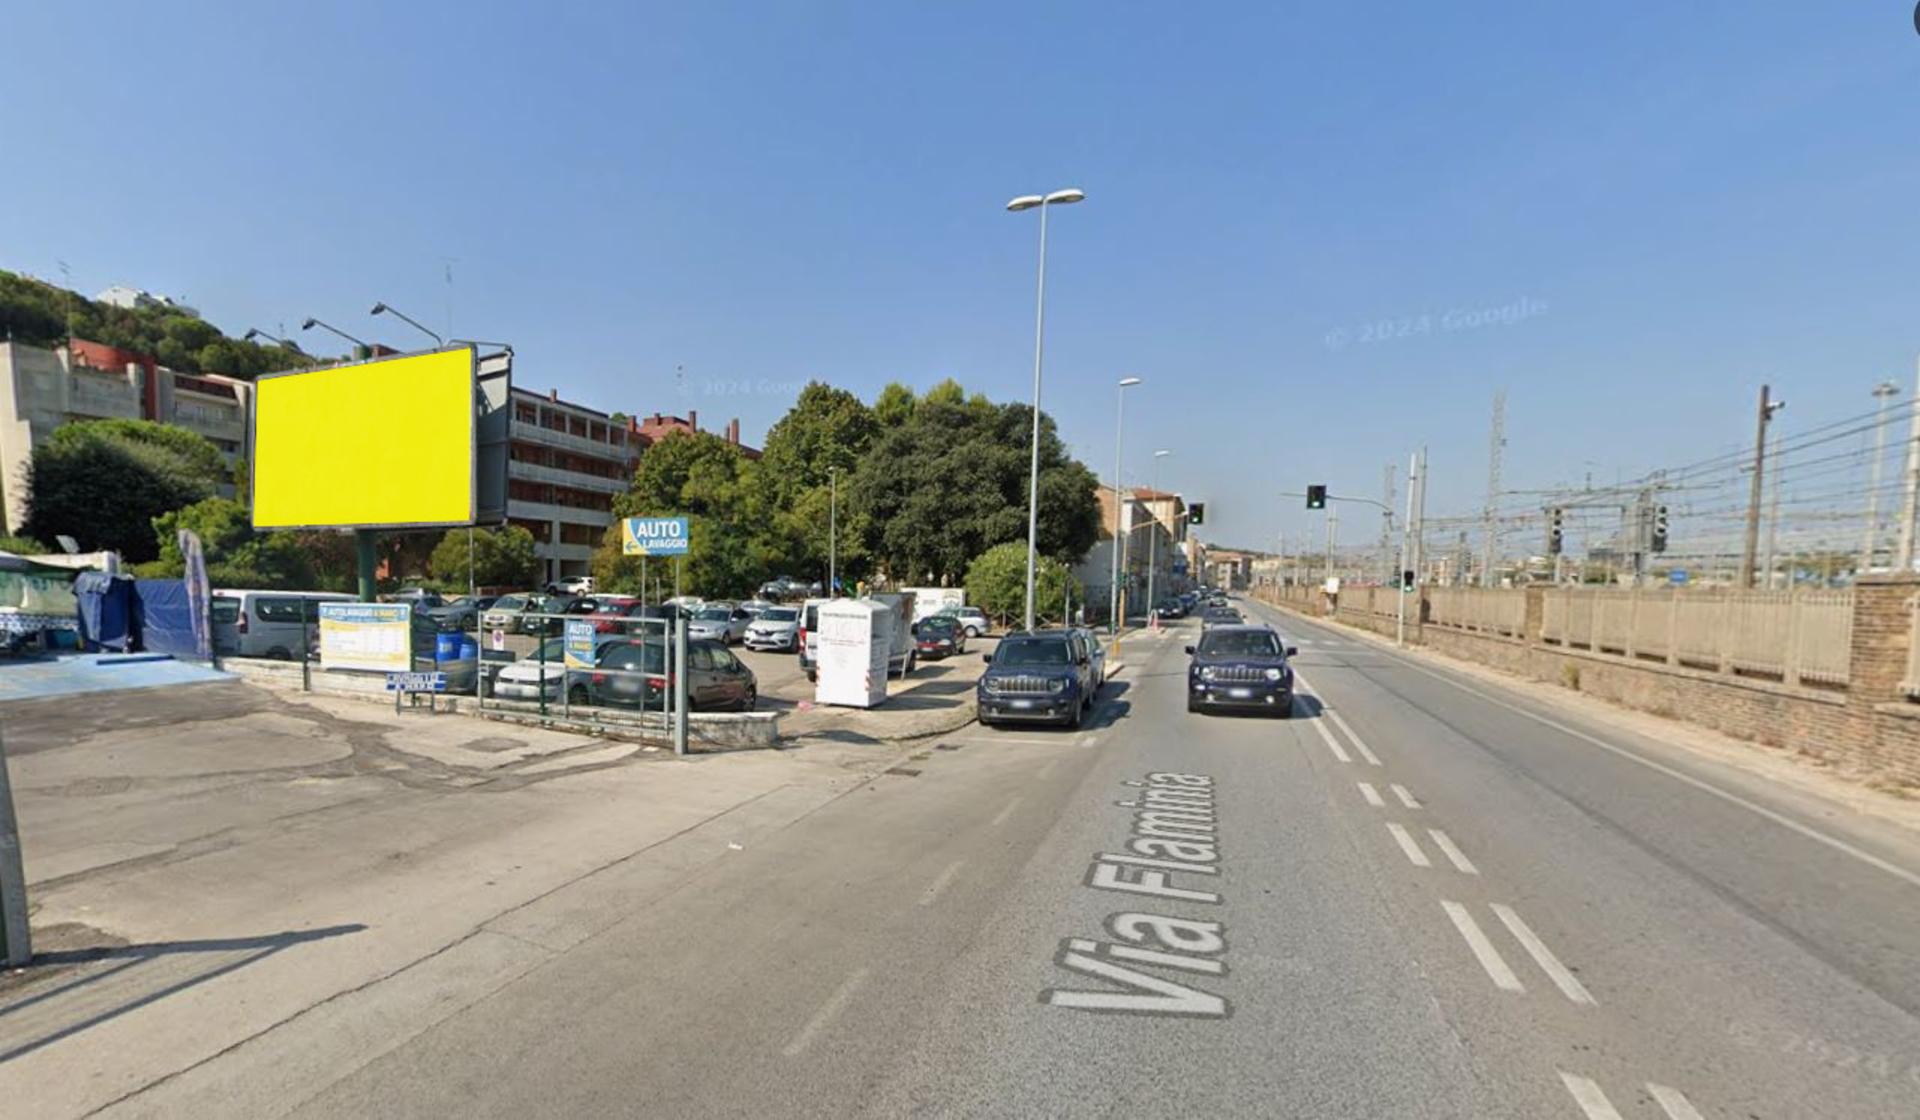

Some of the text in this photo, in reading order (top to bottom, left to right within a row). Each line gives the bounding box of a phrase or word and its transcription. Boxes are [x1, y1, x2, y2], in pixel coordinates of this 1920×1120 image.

[637, 521, 681, 538] AUTO
[642, 539, 688, 549] LAVAGGIO
[569, 624, 592, 635] AUTO
